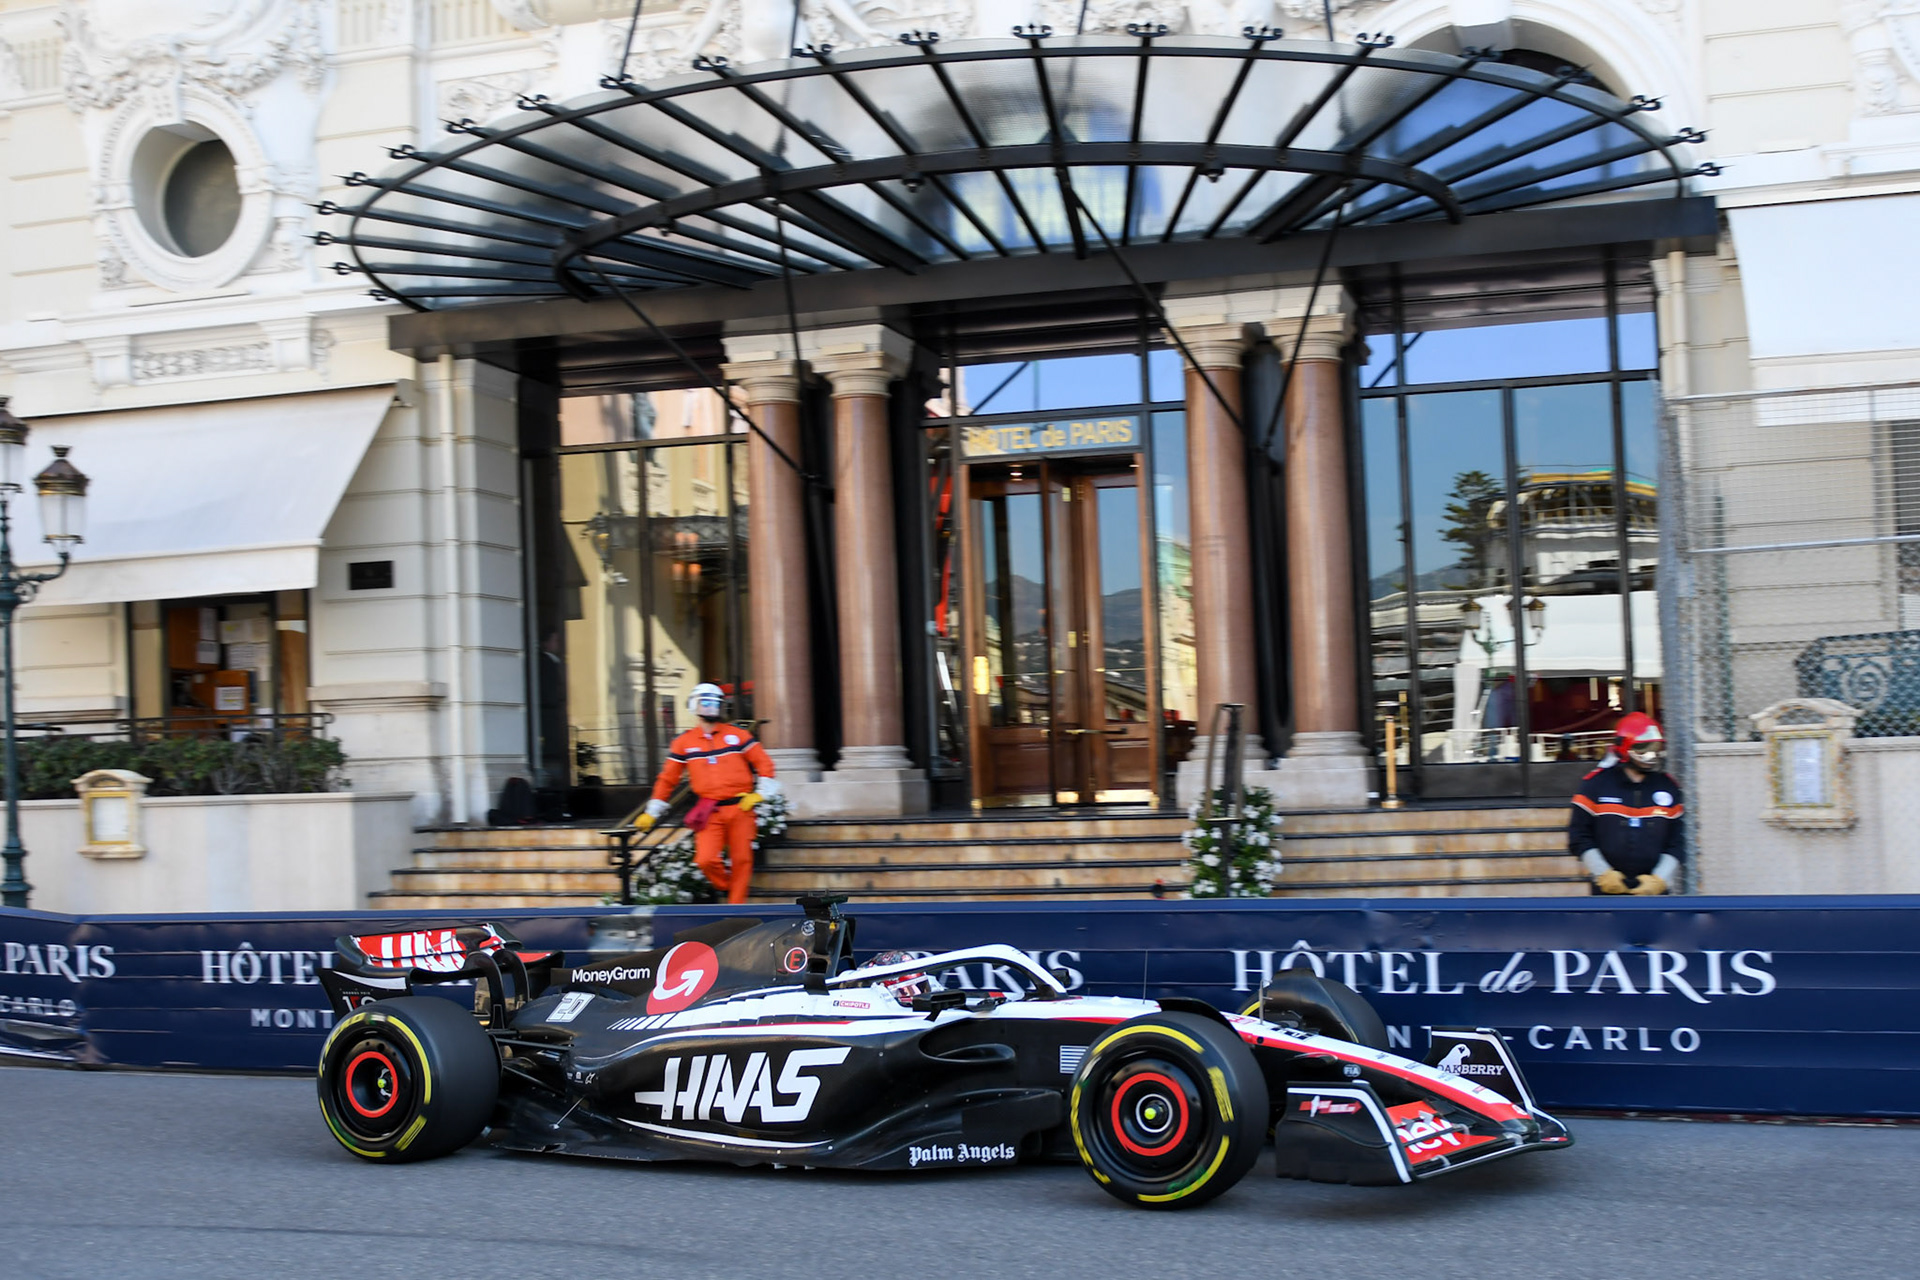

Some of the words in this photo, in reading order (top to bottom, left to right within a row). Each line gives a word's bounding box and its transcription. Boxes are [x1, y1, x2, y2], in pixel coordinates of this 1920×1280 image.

[1041, 424, 1067, 448] de
[1070, 419, 1133, 445] PARIS
[0, 942, 116, 983] PARIS
[789, 950, 802, 969] E
[1231, 940, 1464, 994] HÔTEL
[1479, 952, 1537, 993] de
[1548, 950, 1777, 1004] PARIS
[571, 966, 650, 984] MoneyGram
[908, 950, 1084, 1001] ARS
[251, 1008, 335, 1028] MONT
[1343, 1066, 1361, 1075] FIA
[635, 1047, 852, 1123] HAAS
[909, 1144, 954, 1167] Palm
[957, 1143, 1016, 1163] Angels
